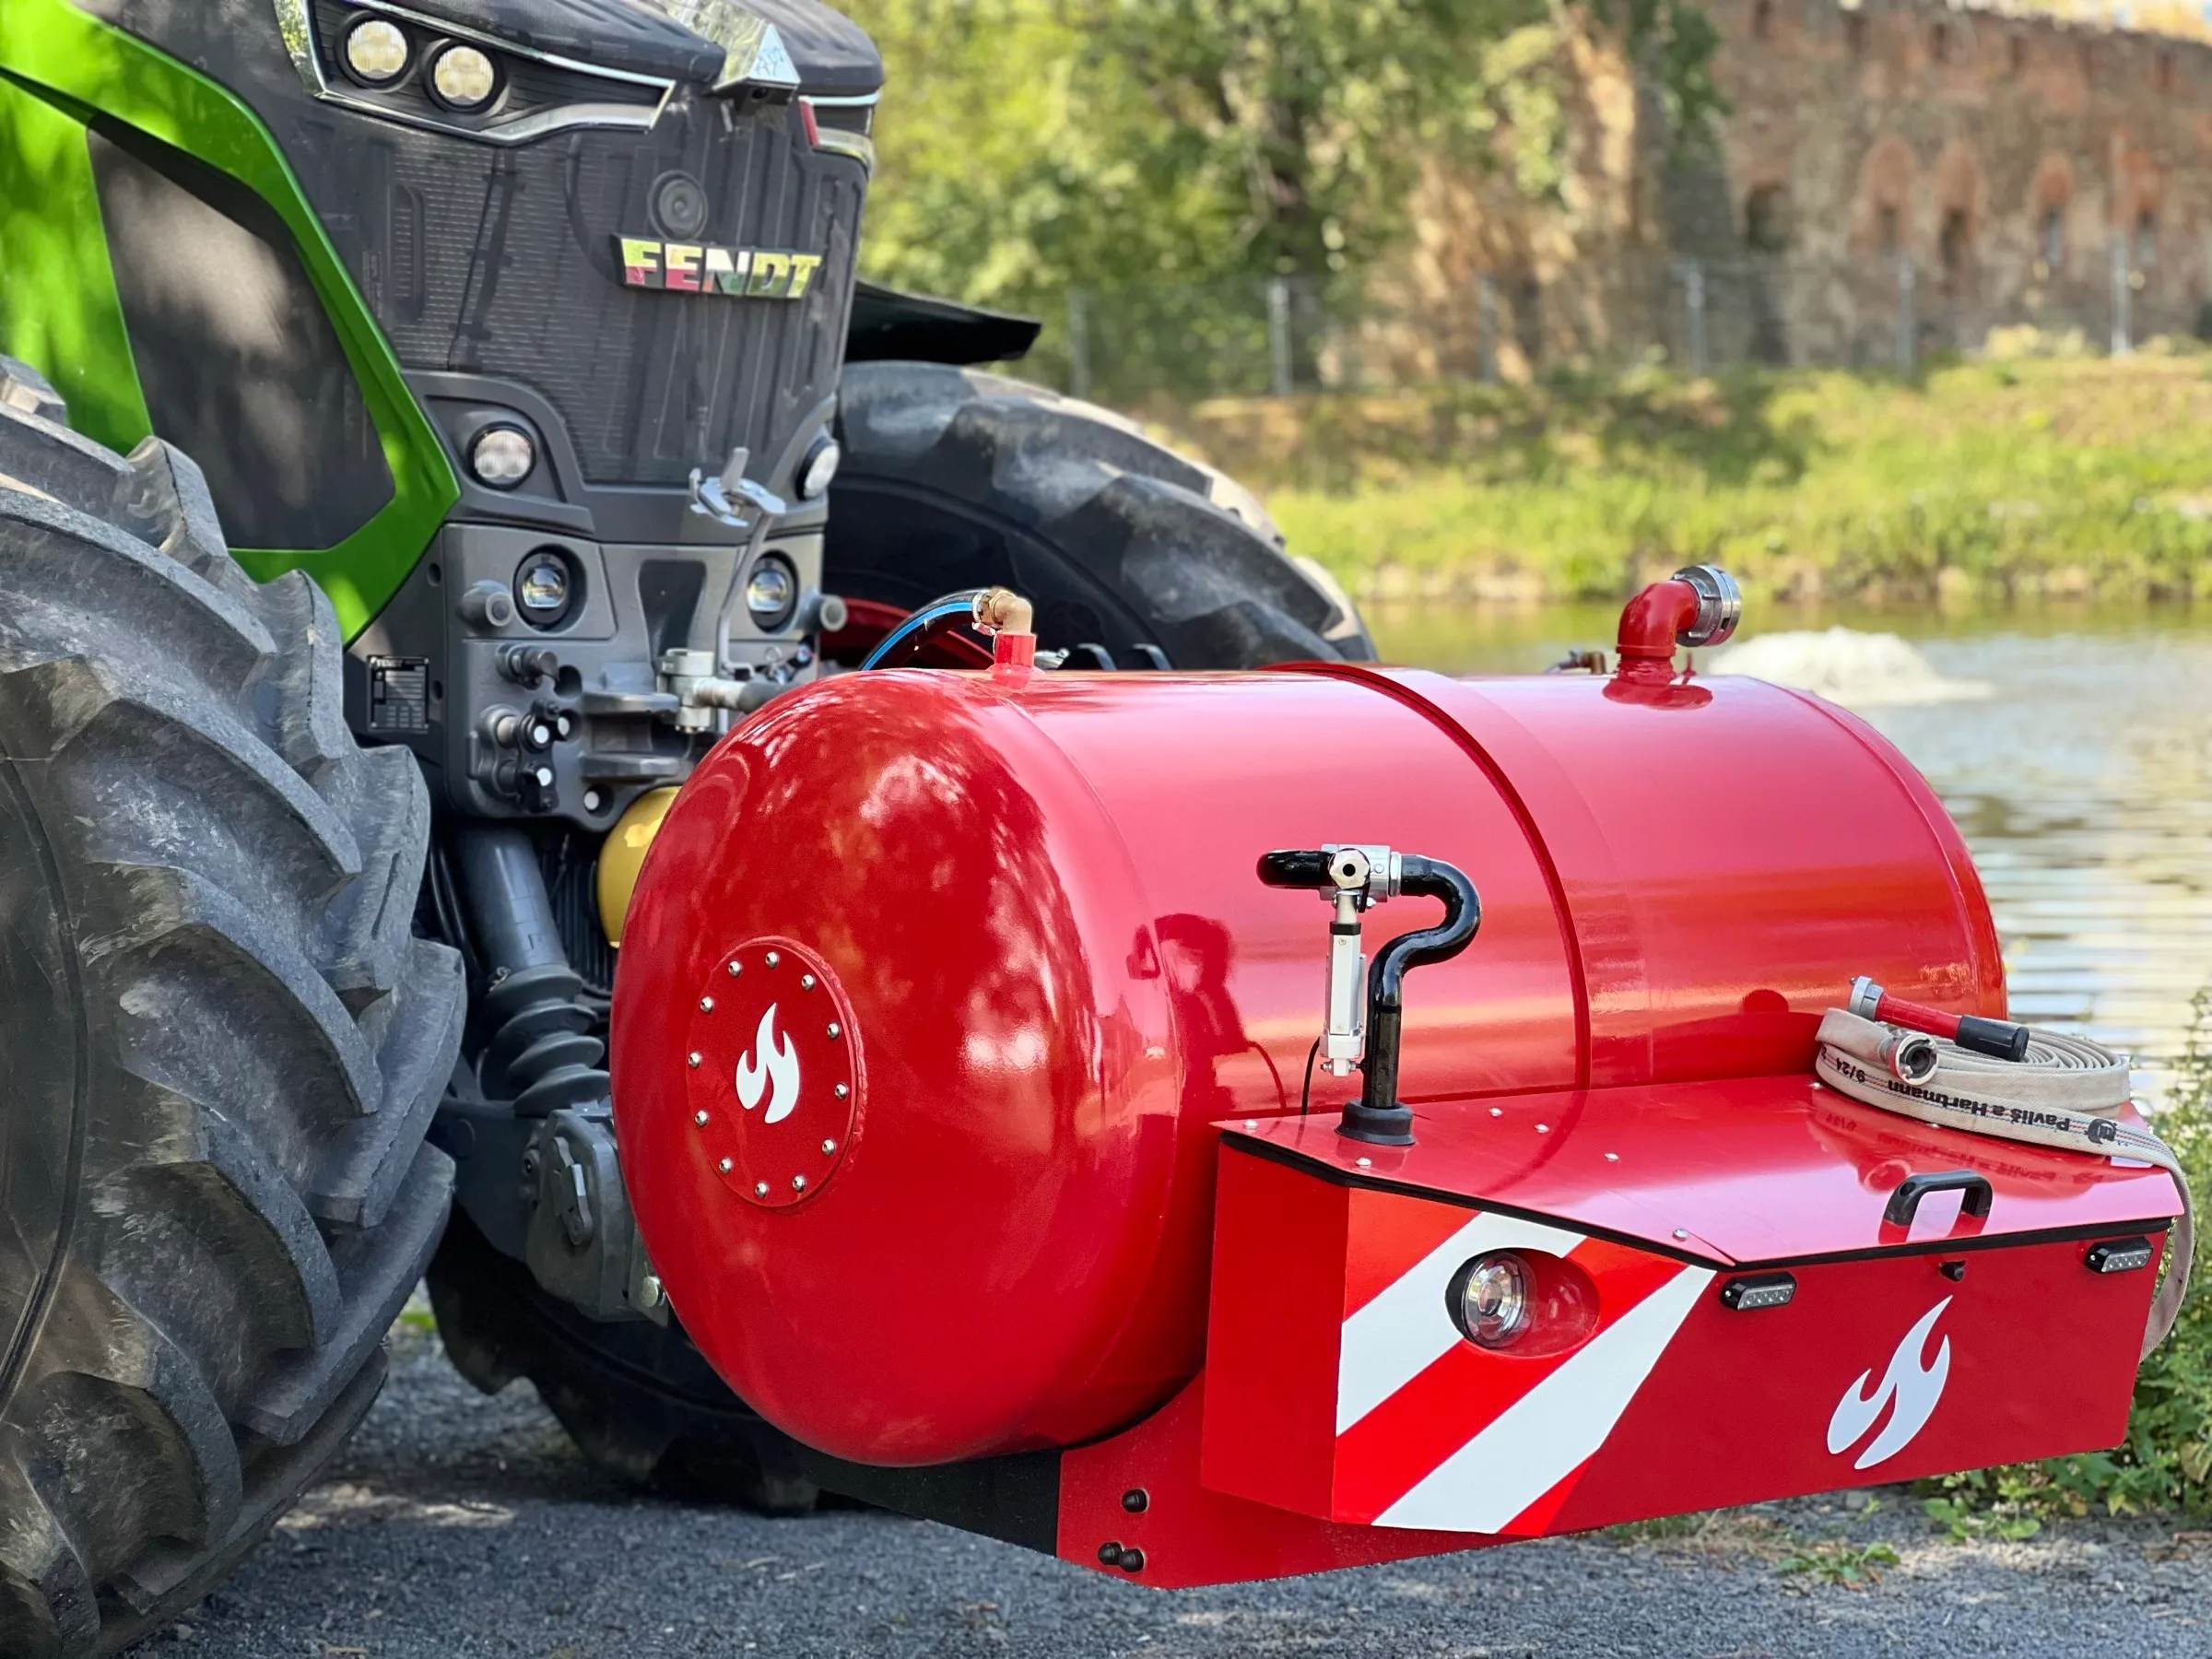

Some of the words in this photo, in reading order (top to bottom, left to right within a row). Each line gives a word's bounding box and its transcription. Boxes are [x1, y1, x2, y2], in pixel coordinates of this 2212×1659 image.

[621, 238, 822, 298] FENDT
[1888, 1079, 1987, 1117] Hartmann
[1993, 1105, 2006, 1115] a
[2011, 1109, 2071, 1132] Pavliš
